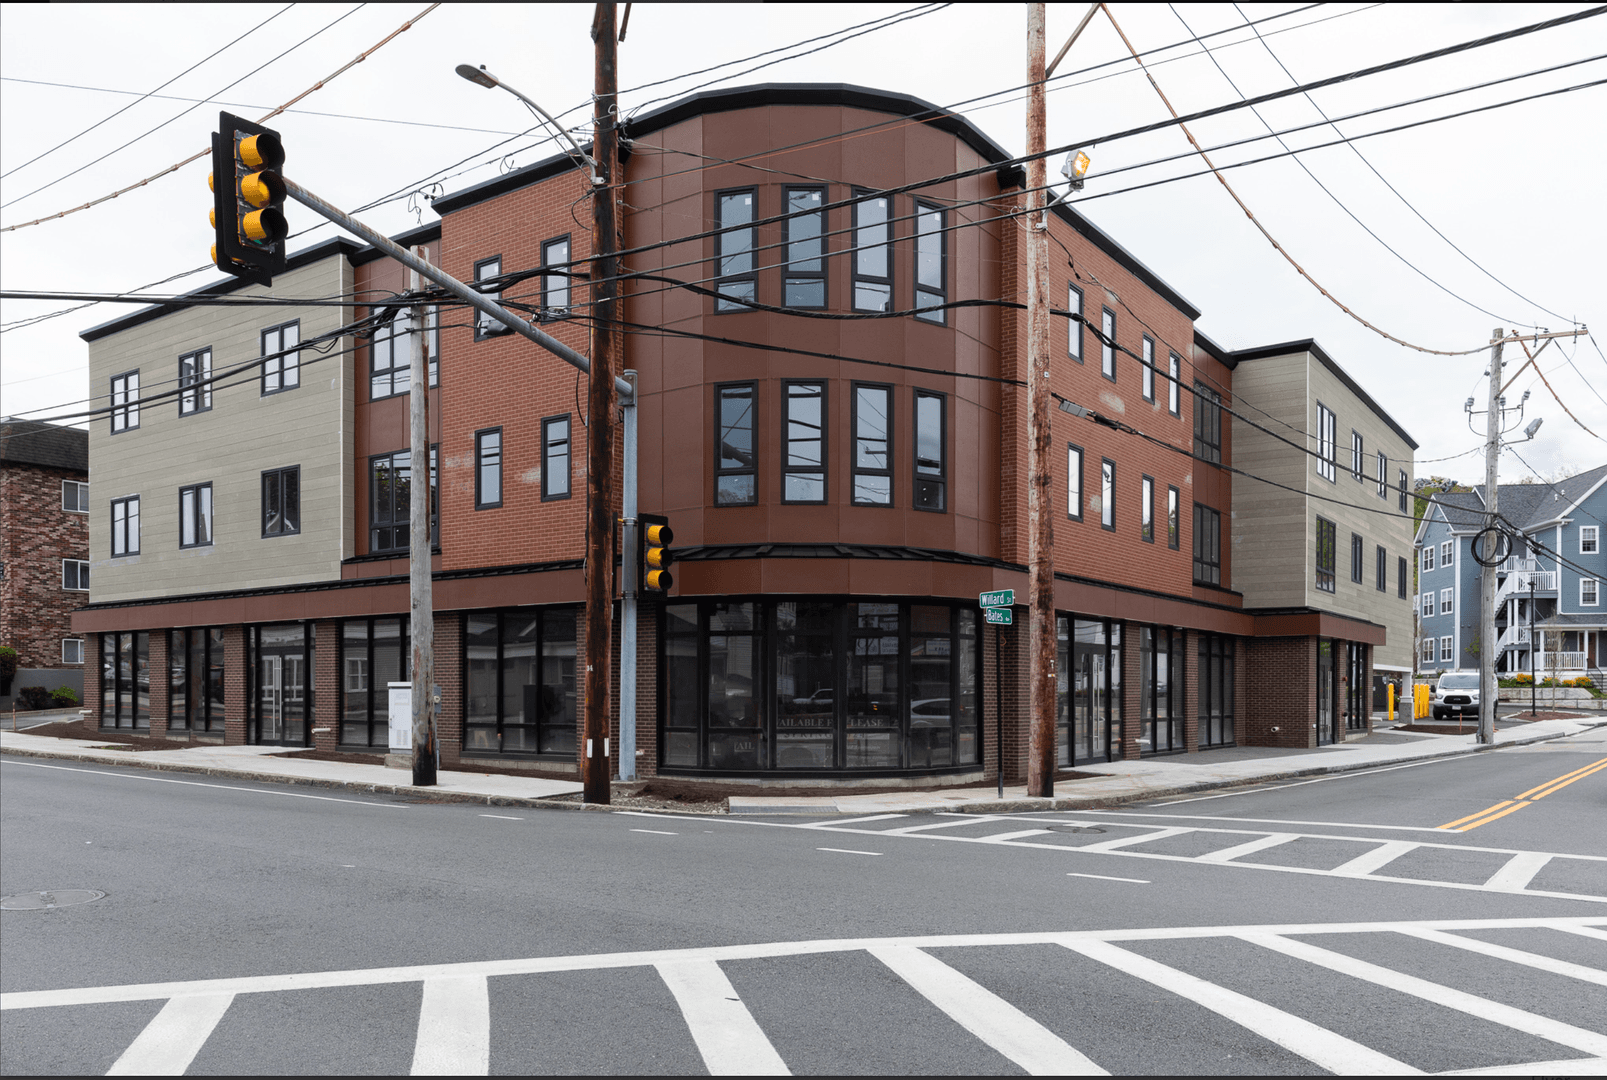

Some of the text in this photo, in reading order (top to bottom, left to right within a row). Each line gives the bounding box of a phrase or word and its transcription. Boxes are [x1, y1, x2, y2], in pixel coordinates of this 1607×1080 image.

[982, 593, 1004, 605] Willard
[987, 609, 1003, 621] Bates
[778, 718, 824, 727] AILABLE
[850, 718, 884, 727] LEASE
